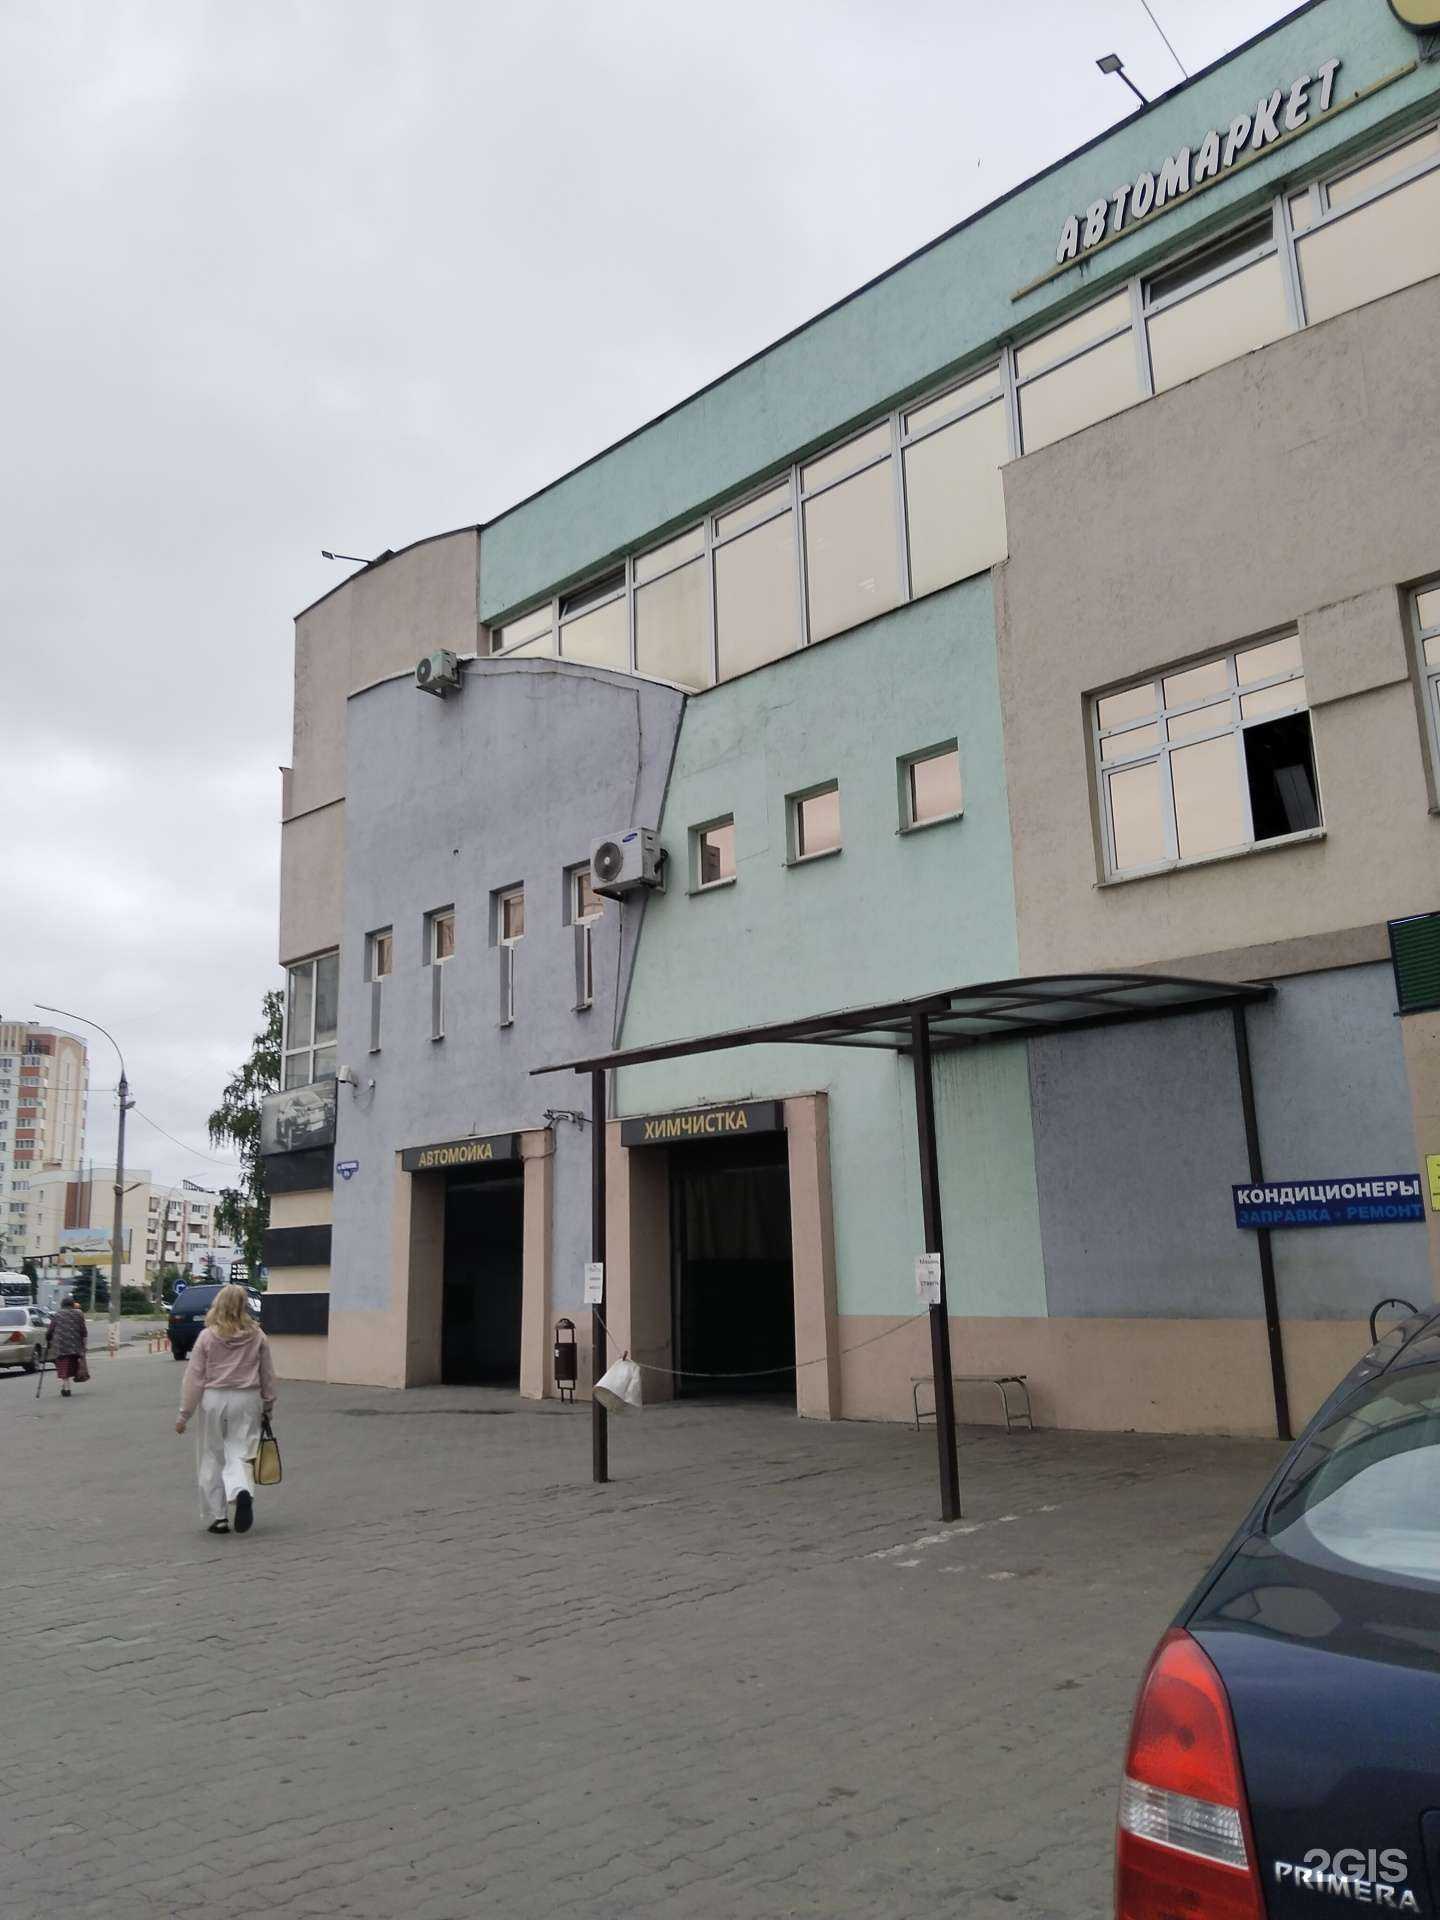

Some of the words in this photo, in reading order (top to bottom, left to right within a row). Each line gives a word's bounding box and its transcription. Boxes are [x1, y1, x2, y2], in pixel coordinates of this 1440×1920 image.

[1056, 58, 1341, 264] АВТОМАРКЕТ
[644, 1110, 748, 1139] ХИМЧИСТКА
[419, 1142, 493, 1166] АВТОМОЙКА
[1238, 1180, 1420, 1204] КОНДИЦИОНЕРЫ
[1240, 1208, 1330, 1224] ЗАПРАВКА
[1347, 1204, 1422, 1219] РЕМОНТ
[1275, 1861, 1420, 1912] PRIMERA
